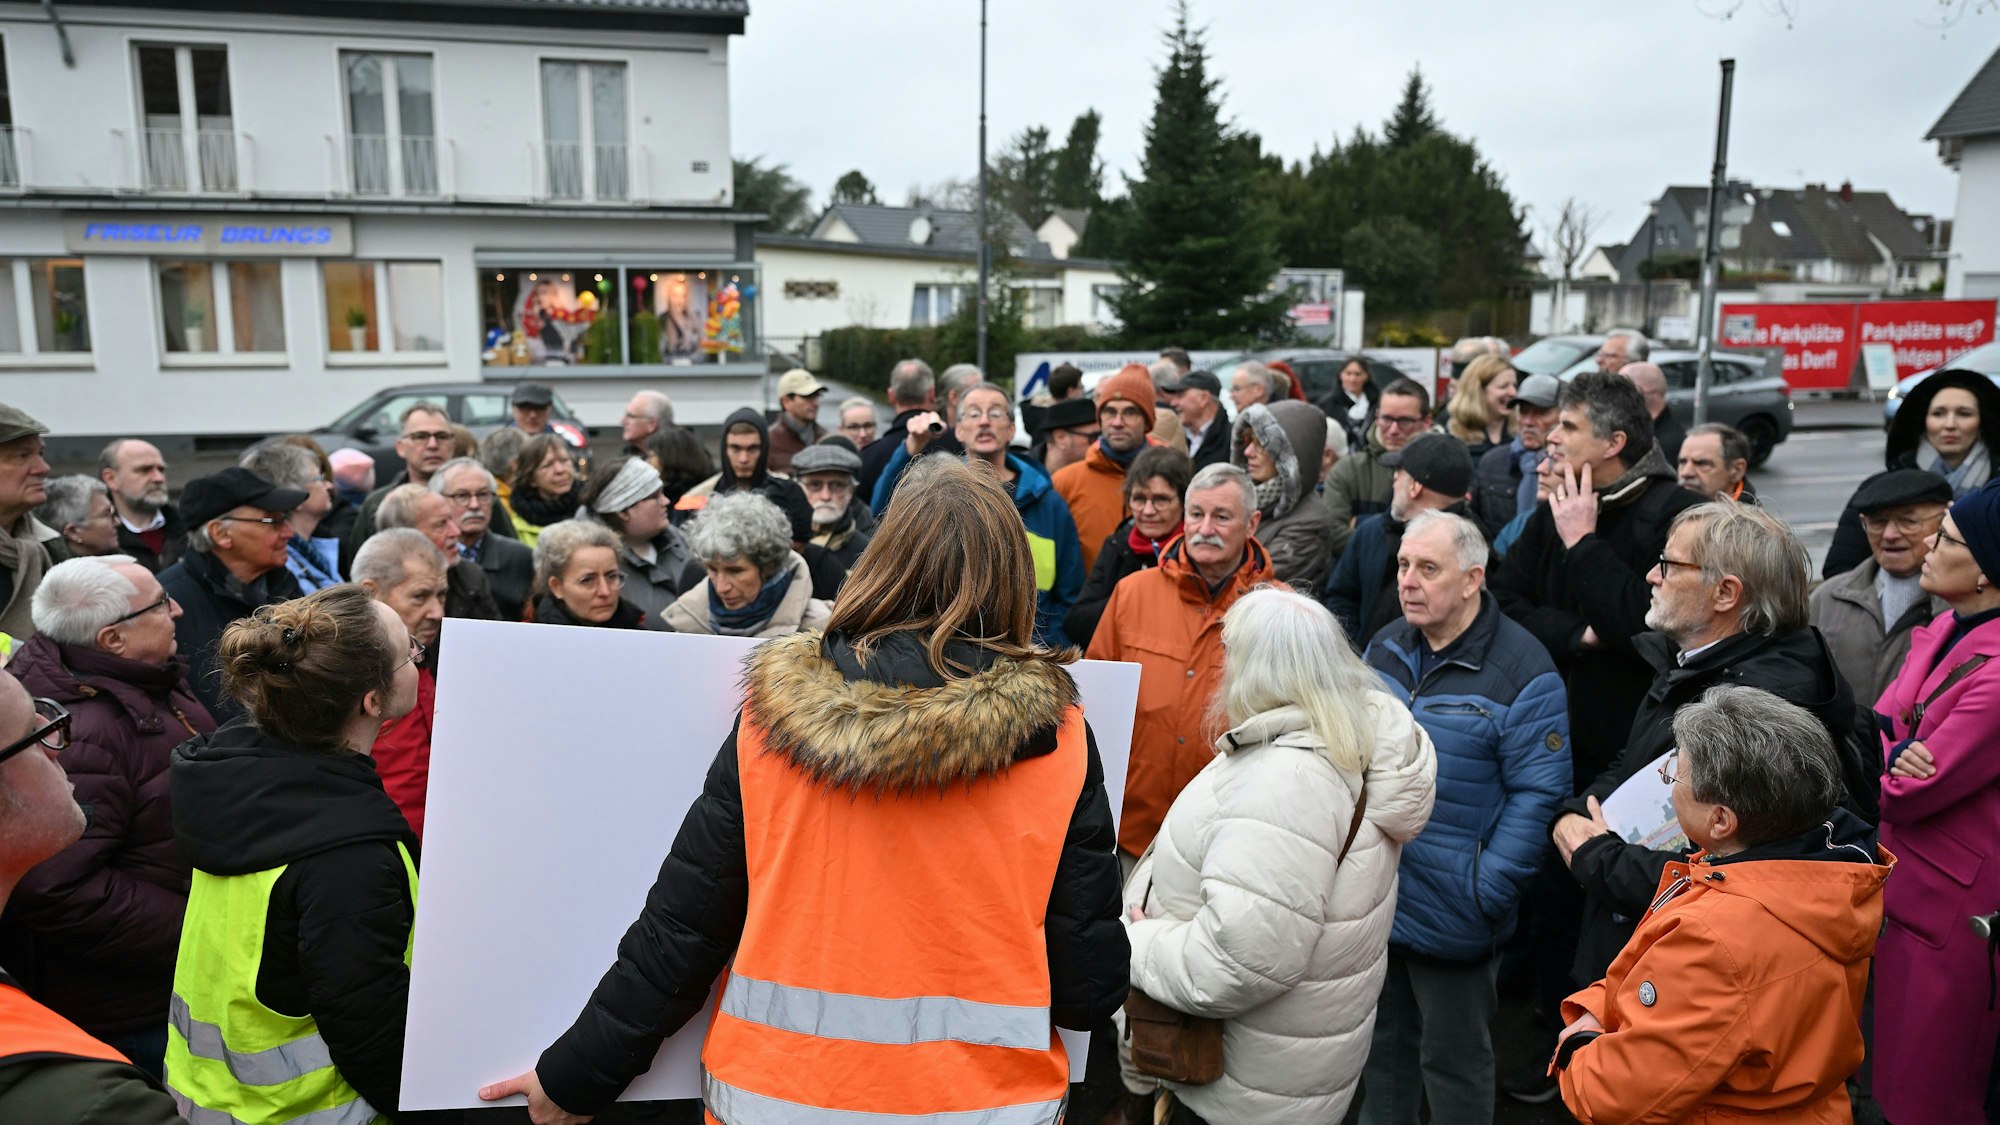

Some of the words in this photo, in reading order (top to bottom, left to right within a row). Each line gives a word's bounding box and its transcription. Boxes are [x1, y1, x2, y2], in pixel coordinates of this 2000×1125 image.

[84, 223, 203, 242] FRISEUR
[220, 226, 332, 245] BRUNGS
[1770, 322, 1845, 348] Parkplätze
[1862, 321, 1943, 344] Parkplätze
[1944, 318, 1985, 342] weg?
[1782, 353, 1800, 370] as
